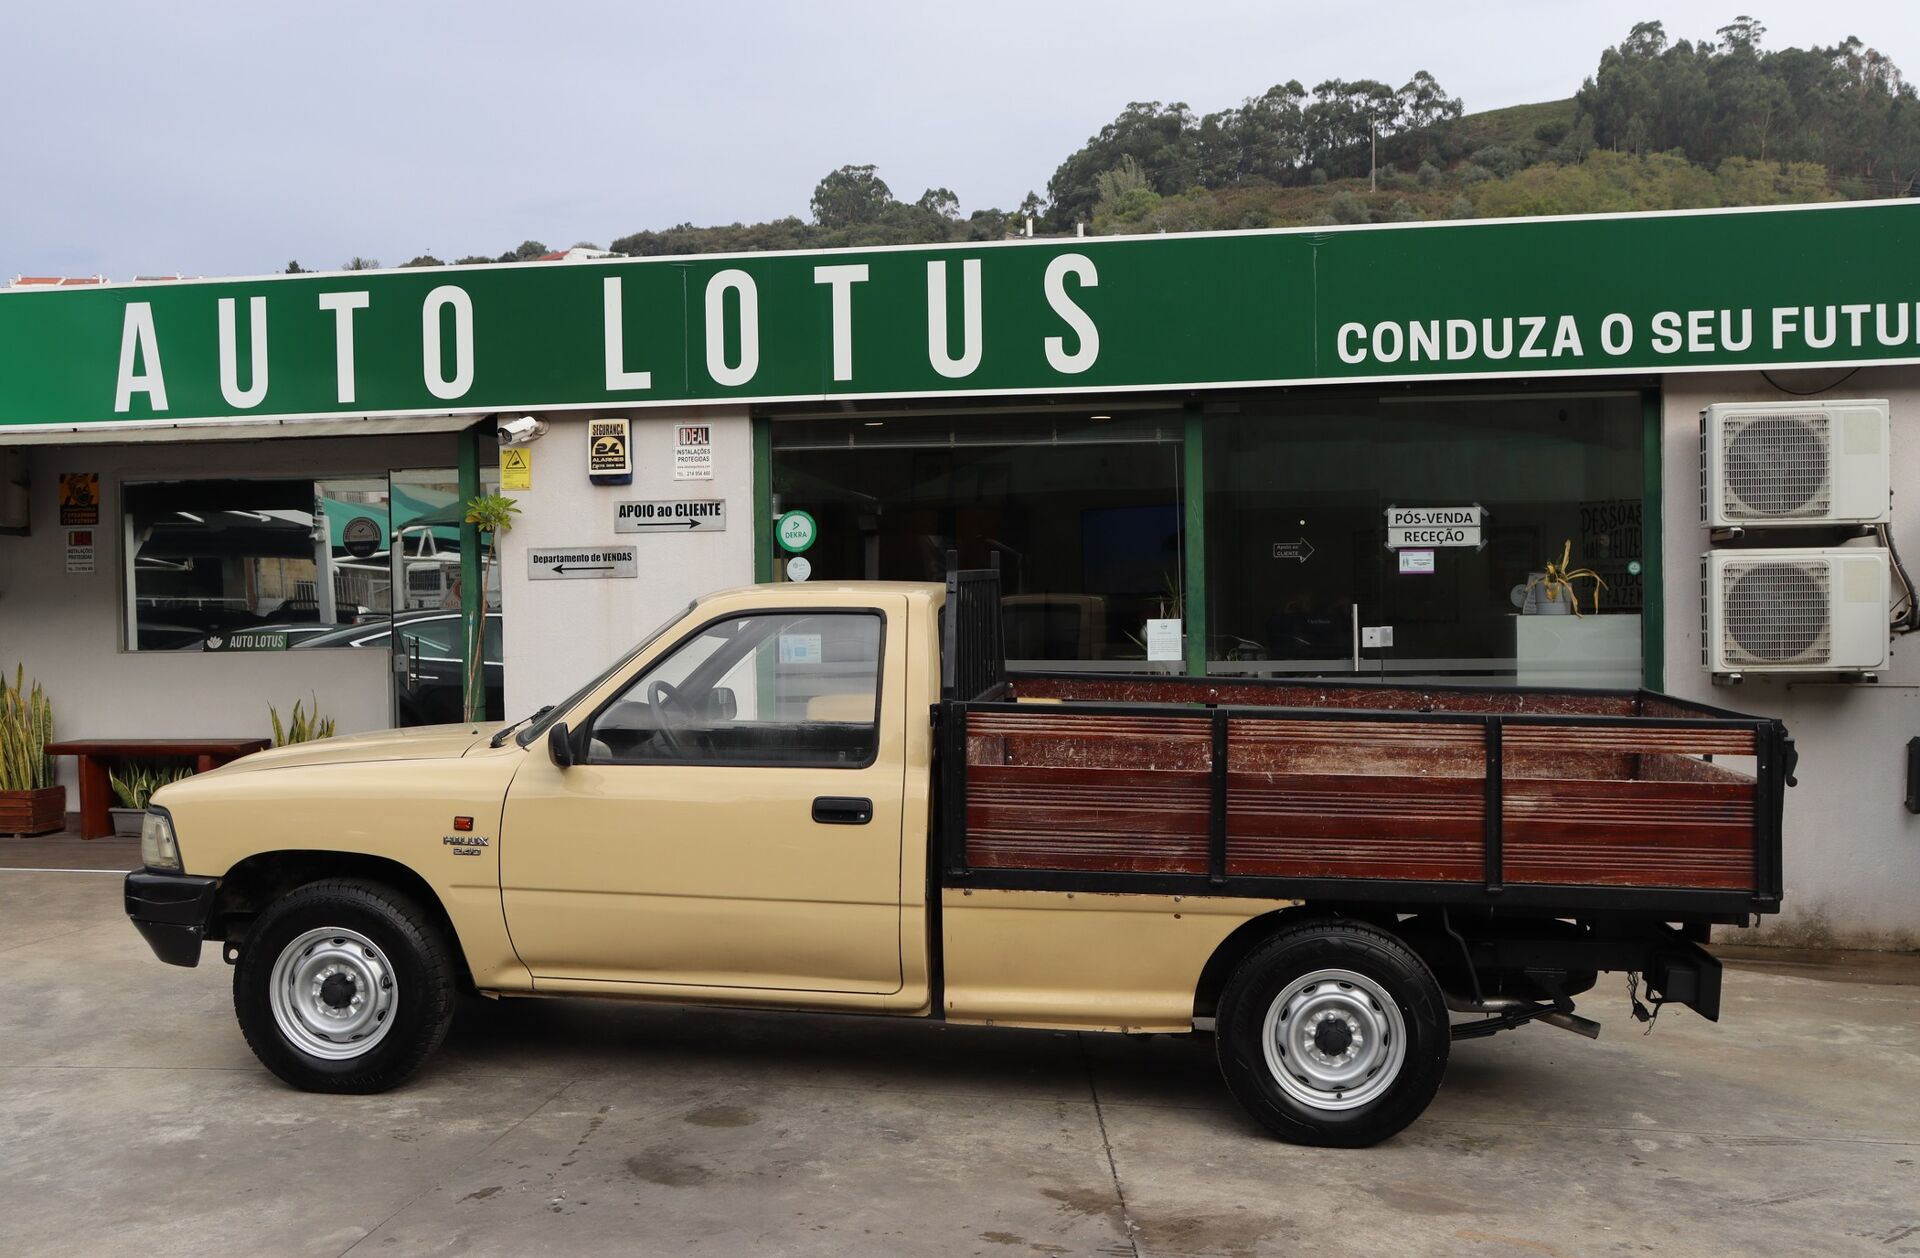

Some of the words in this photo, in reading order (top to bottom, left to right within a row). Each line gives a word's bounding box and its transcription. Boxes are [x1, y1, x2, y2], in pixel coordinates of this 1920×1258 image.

[114, 285, 474, 412] AUTO
[604, 253, 1100, 392] LOTUS
[1337, 315, 1583, 363] CONDUZA
[1601, 313, 1634, 355] O
[1652, 309, 1752, 353] SEU
[1772, 302, 1920, 349] FUTU
[592, 424, 624, 436] SEGURANÇA
[681, 428, 708, 444] IDEAL
[595, 442, 619, 455] 24
[676, 448, 711, 456] INSTALAÇÕES
[619, 504, 654, 518] APOIO
[657, 505, 673, 517] ao
[675, 502, 721, 517] CLIENTE
[1395, 510, 1474, 525] PÓS-VENDA
[785, 531, 807, 539] DEKRA
[1404, 528, 1465, 545] RECEÇÃO
[533, 554, 590, 565] Departamento
[591, 554, 601, 562] de
[602, 552, 632, 562] VENDAS
[230, 635, 253, 648] AUTO
[255, 635, 284, 648] LOTUS
